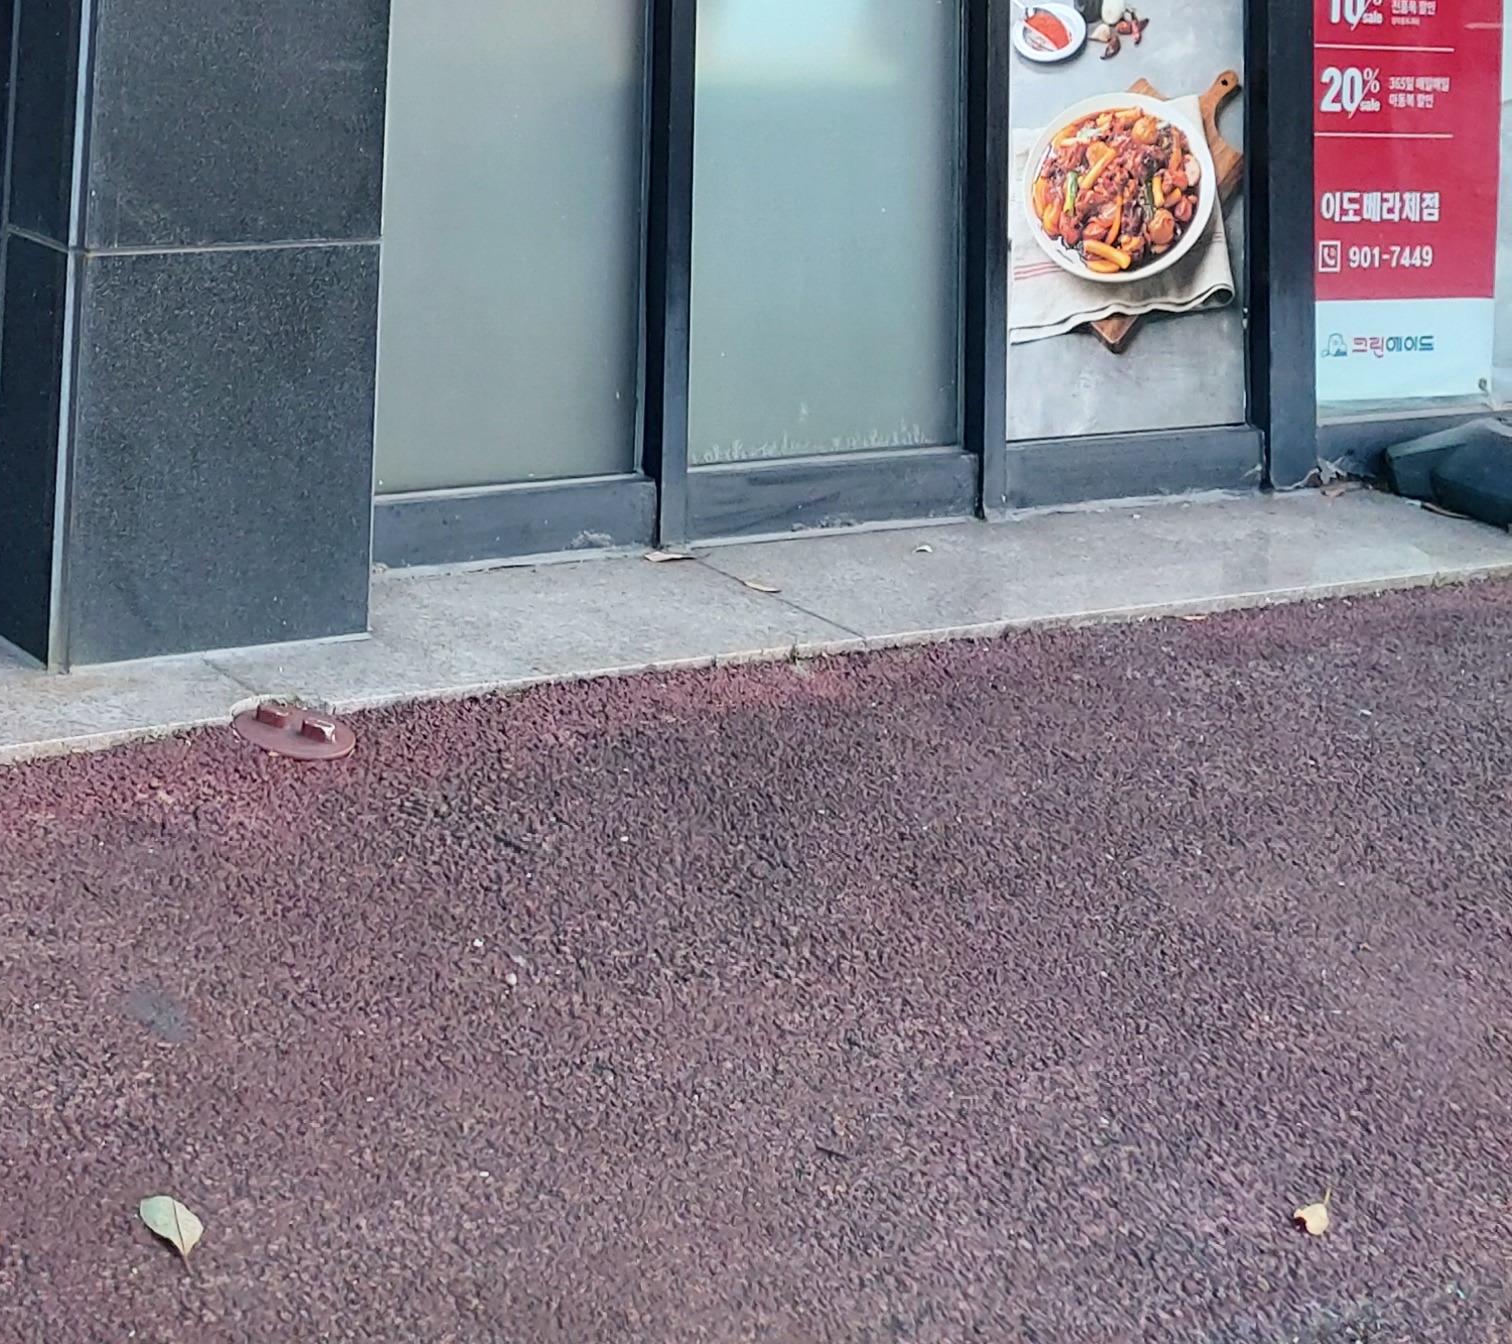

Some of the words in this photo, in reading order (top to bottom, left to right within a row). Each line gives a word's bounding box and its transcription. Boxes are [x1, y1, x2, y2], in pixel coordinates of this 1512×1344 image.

[1319, 66, 1381, 120] 20%
[1348, 245, 1434, 269] 901-7449
[1351, 334, 1435, 359] 크린에이드
